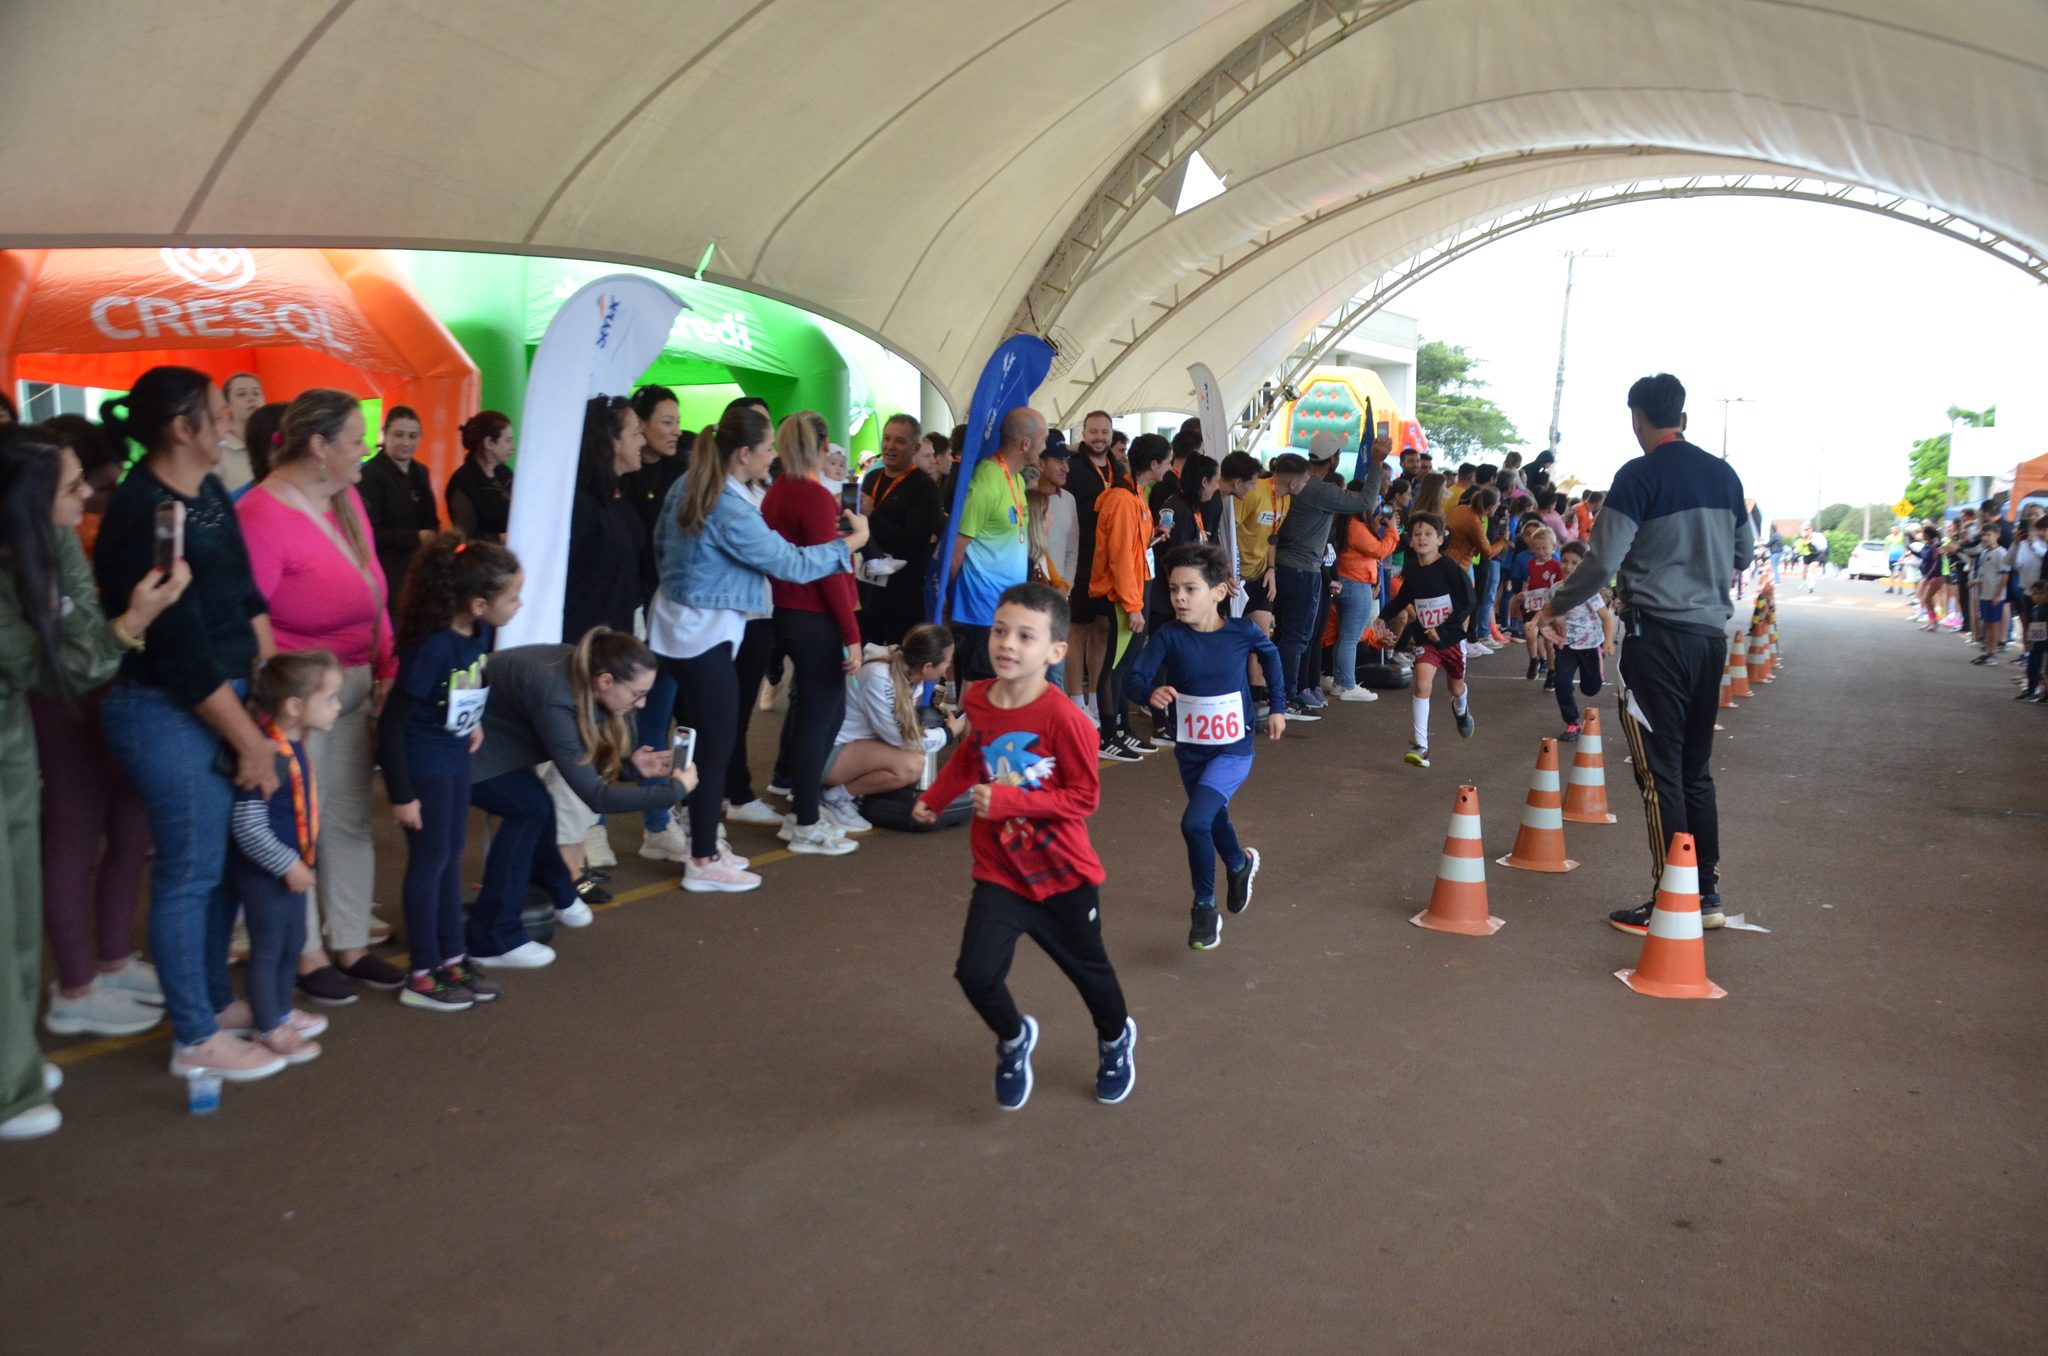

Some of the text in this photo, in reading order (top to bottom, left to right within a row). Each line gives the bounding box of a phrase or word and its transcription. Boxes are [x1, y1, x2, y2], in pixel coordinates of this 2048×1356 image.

[90, 296, 352, 352] CRESOL
[1419, 607, 1449, 627] 1275
[1184, 711, 1239, 740] 1266
